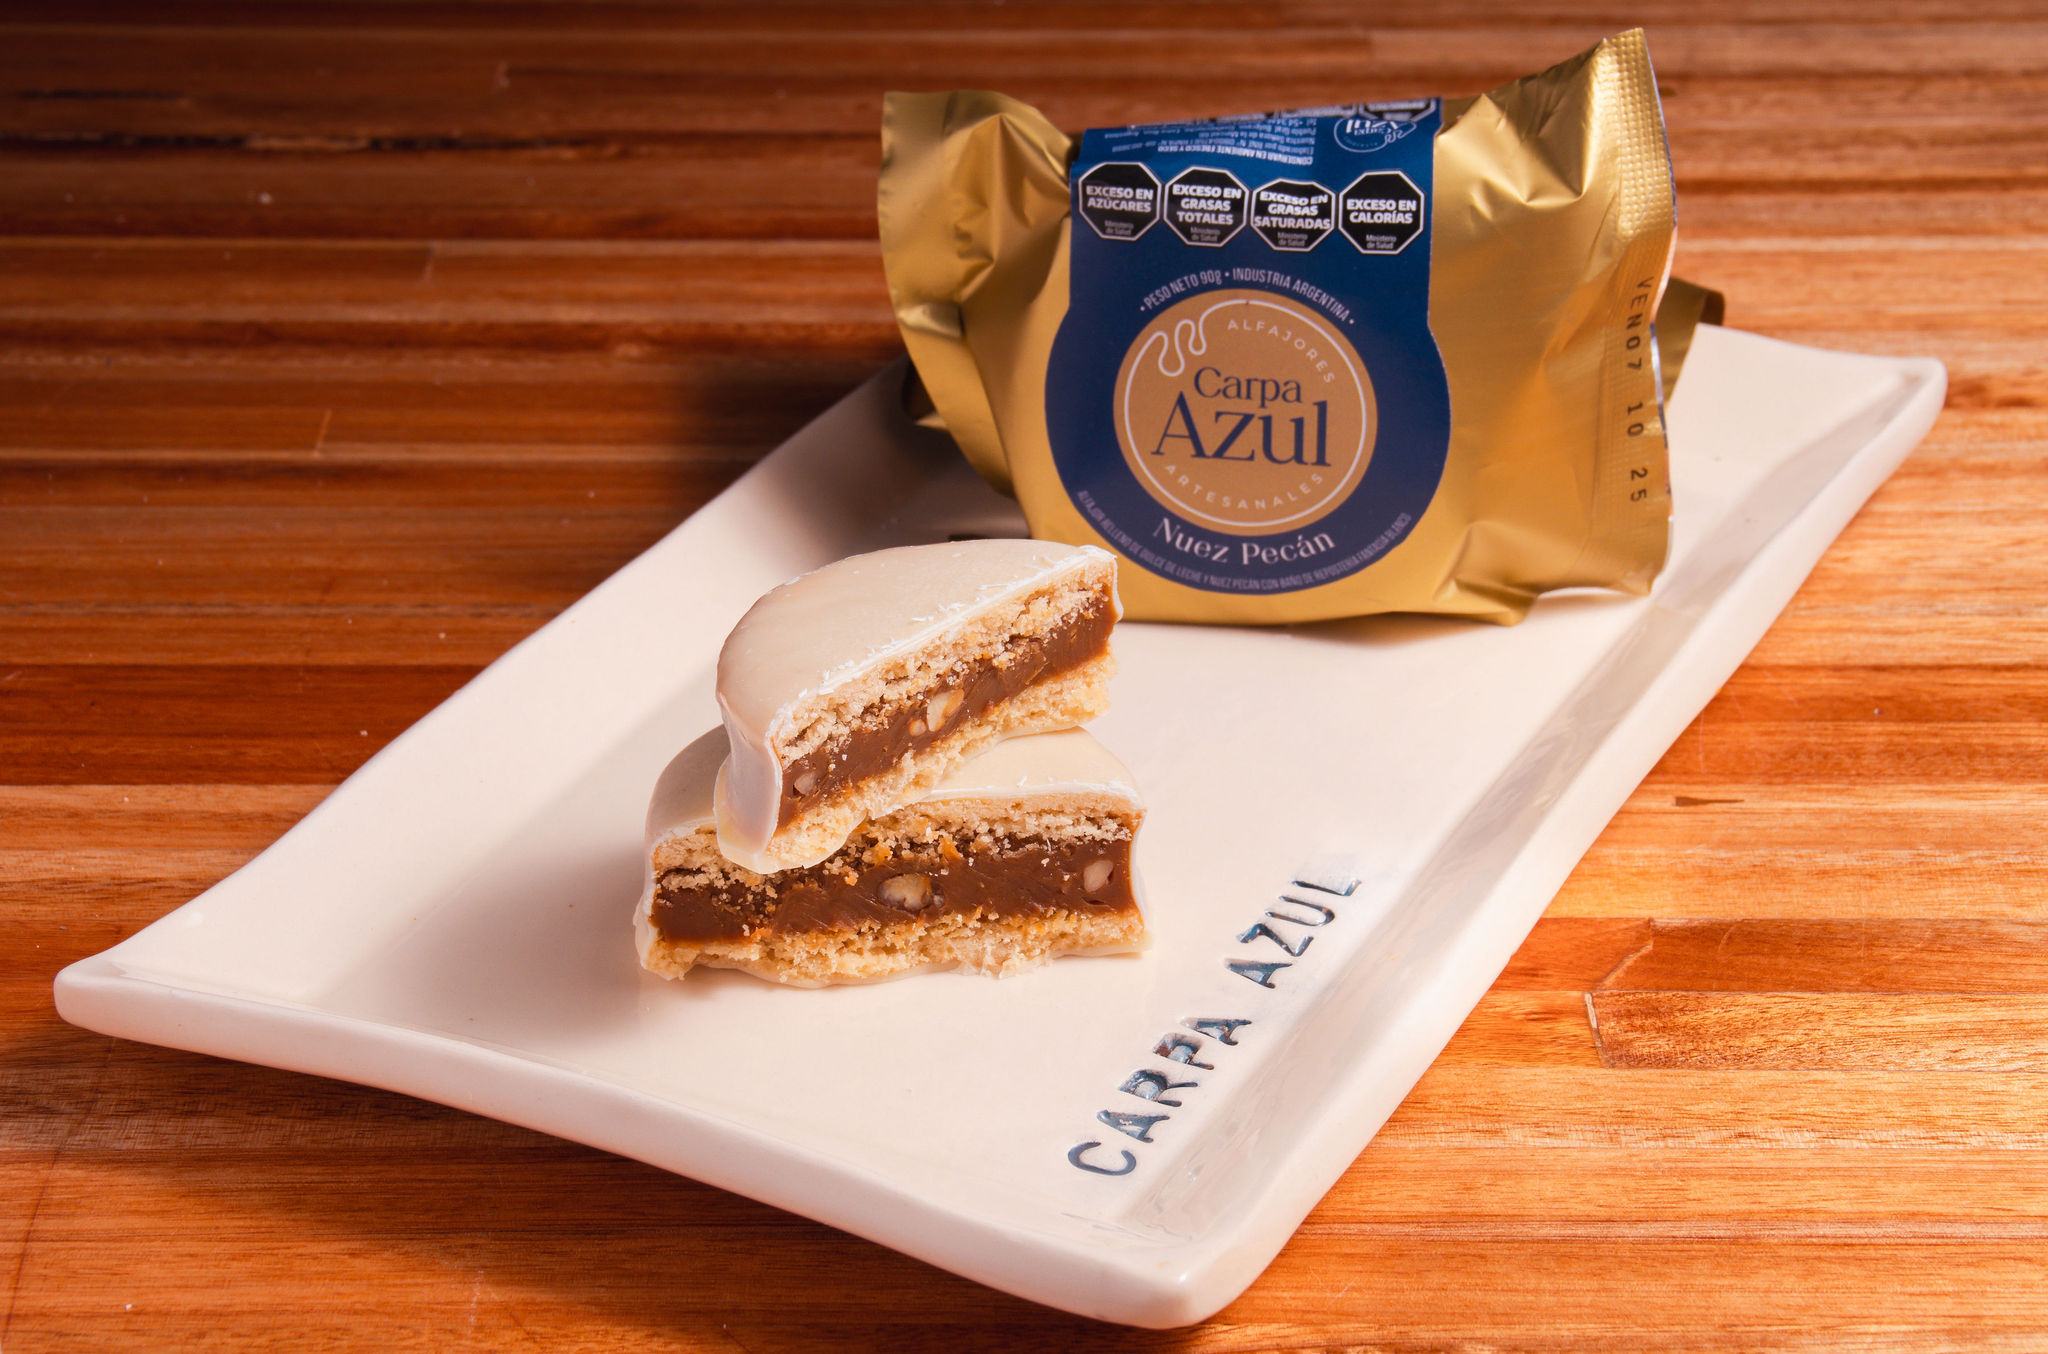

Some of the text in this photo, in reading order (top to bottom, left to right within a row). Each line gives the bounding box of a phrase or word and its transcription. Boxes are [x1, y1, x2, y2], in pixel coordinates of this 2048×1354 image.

[1157, 144, 1314, 166] CONSERVAR EN AMBIENTE FRESCO Y SECO
[1086, 185, 1154, 201] EXCESO EN
[1172, 184, 1242, 200] EXCESO EN
[1259, 190, 1329, 206] EXCESO EN
[1087, 196, 1152, 213] AZÚCARES
[1180, 198, 1232, 212] GRASAS
[1267, 203, 1319, 217] GRASAS
[1346, 198, 1417, 212] EXCESO EN
[1176, 211, 1234, 226] TOTALES
[1254, 215, 1331, 230] SATURADAS
[1349, 209, 1413, 225] CALORÍAS
[1143, 267, 1351, 322] PESO NETO 90g INDUSTRIA ARGENTINA
[1227, 319, 1336, 384] ALFAJORES
[1194, 366, 1302, 408] Carpa
[1150, 390, 1332, 467] Azul
[1626, 401, 1645, 437] 10
[1163, 462, 1325, 510] ARTESANALES
[1630, 467, 1648, 502] 25
[1138, 547, 1168, 571] DULCE
[1164, 561, 1176, 575] DE
[1175, 566, 1203, 584] LECHE
[1208, 574, 1232, 588] NUEZ
[1261, 577, 1279, 590] CON
[1302, 571, 1315, 585] DE
[1384, 512, 1412, 540] BLANCO
[1152, 516, 1336, 565] Nuez Pecán
[1067, 877, 1362, 1176] CARPA AZUL
